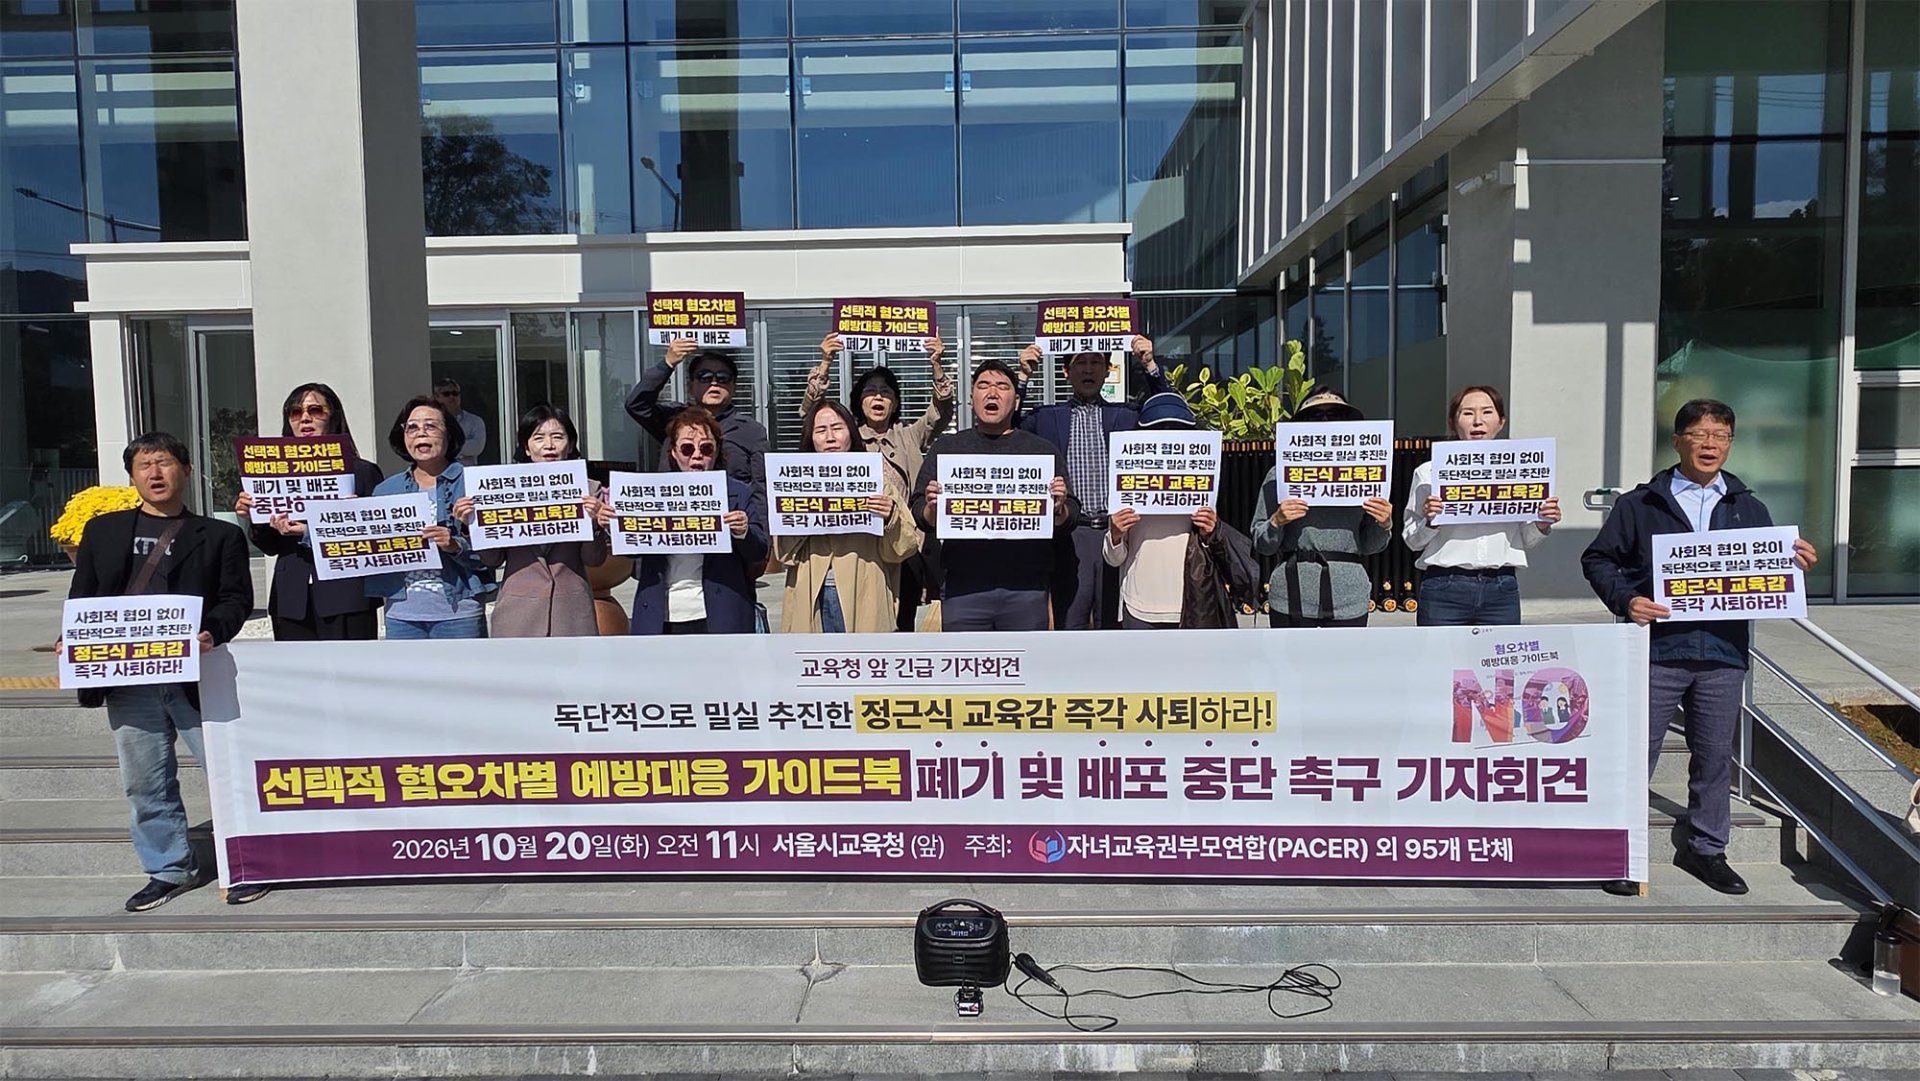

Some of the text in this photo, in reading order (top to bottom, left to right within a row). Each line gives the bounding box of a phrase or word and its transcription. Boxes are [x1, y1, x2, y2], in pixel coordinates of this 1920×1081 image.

[840, 305, 928, 320] 선택적 혐오차별
[1044, 306, 1130, 320] 선택적 혐오차별
[885, 322, 929, 334] 가이드북
[1088, 321, 1131, 333] 가이드북
[846, 337, 921, 352] 폐기 및 배포
[1049, 338, 1124, 352] 폐기 및 배포
[1289, 434, 1381, 447] 사회적 협의 없이
[243, 443, 342, 459] 선택적 혐오차별
[1121, 443, 1211, 455] 사회적 협의 없이
[1282, 450, 1387, 462] 독단적으로 밀실 추진한
[293, 458, 345, 473] 가이드북
[1166, 459, 1216, 470] 밀실 추진한
[1446, 451, 1544, 466] 사회적 협의 없이
[779, 465, 870, 478] 사회적 협의 없이
[950, 467, 1041, 480] 사회적 협의 없이
[1289, 466, 1382, 482] 정근식 교육감
[1438, 467, 1550, 481] 독단적으로 밀실 추진한
[252, 478, 339, 494] 폐기 및 배포
[478, 473, 574, 490] 사회적 협의 없이
[773, 481, 877, 493] 독단적으로 추진한
[944, 483, 1048, 494] 독단적으로 밀실 추진한
[1121, 475, 1211, 490] 정근식 교육감
[527, 488, 582, 502] 밀실 추진한
[620, 485, 713, 498] 사회적 협의 없이
[1289, 484, 1382, 498] 즉각 사퇴하라!
[1446, 484, 1544, 500] 정근식 교육감
[615, 500, 721, 512] 독단적으로 밀실 추진한
[781, 498, 824, 512] 정근식
[1121, 492, 1209, 506] 즉각 사퇴하라!
[320, 506, 417, 524] 사회적 협의 없이
[482, 505, 578, 525] 정근식 교육감
[951, 500, 1041, 515] 정근식 교육감
[1444, 503, 1474, 516] 즉각
[624, 516, 716, 531] 정근식 교육감
[782, 514, 872, 527] 즉각 사퇴하라!
[950, 517, 1040, 531] 즉각 사퇴하라!
[315, 523, 392, 538] 독단적으로 밀실
[485, 521, 580, 540] 즉각 사퇴하라!
[325, 537, 424, 557] 정근식 교육감
[625, 533, 717, 547] 즉각 사퇴하라!
[1669, 541, 1783, 559] 사회적 협의 없이
[329, 551, 427, 571] 즉각 사퇴하라!
[1661, 557, 1794, 574] 독단적으로 밀실 추진한
[1670, 576, 1786, 596] 정근식 교육감
[1671, 595, 1788, 612] 즉각 사퇴하라!
[74, 608, 185, 624] 사회적 협의 없이
[66, 624, 192, 640] 독단적으로 밀실 추진한
[74, 641, 184, 662] 정근식 교육감
[1494, 640, 1539, 655] 혐오차별
[1481, 651, 1559, 668] 예방대응 가이드북
[75, 660, 183, 679] 즉각 사퇴하라!
[801, 657, 1020, 679] 교육청 앞 긴급 기자회견
[1452, 667, 1589, 744] NO
[554, 696, 1273, 733] 독단적으로 밀실 추진한 정근식 교육감 즉각 사퇴하라!
[262, 755, 1589, 806] 선택적 혐오차별 예방대응 가이드북 폐기 및 배포 중단 촉구 기자회견
[392, 830, 1513, 863] 2026년 10월 20일(화) 오전 11시 서울시교육청 (앞) 주최: 자녀교육권부모연합(PACER) 외 95개 단체
